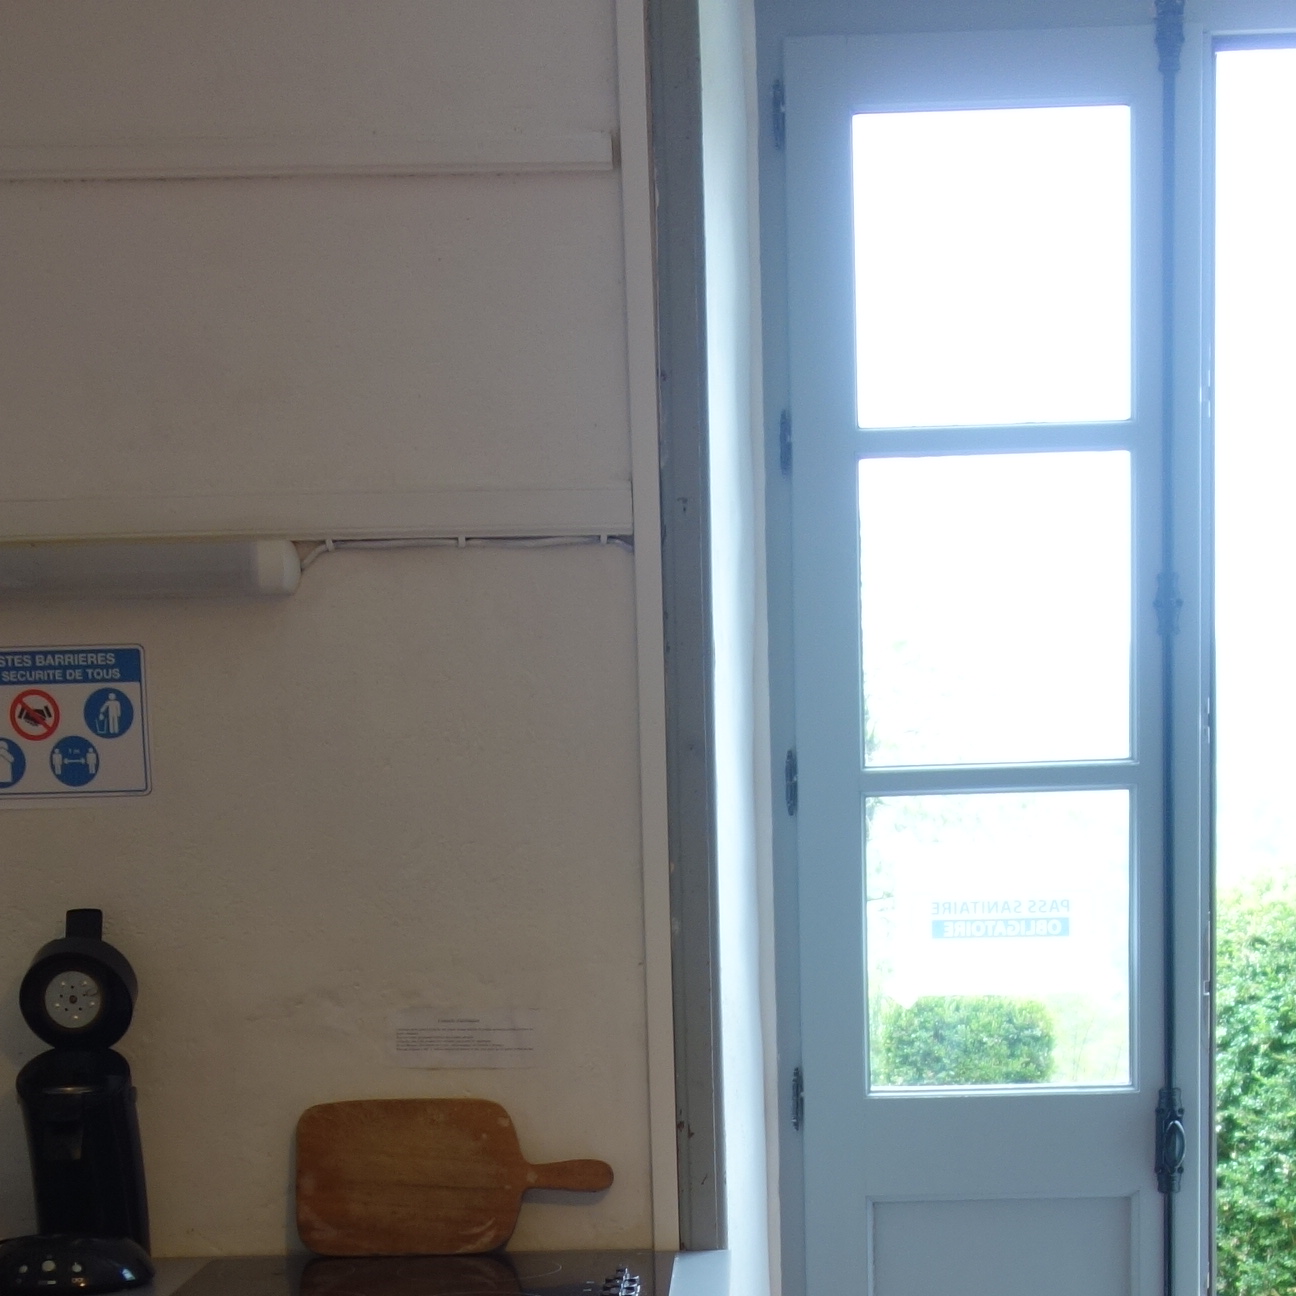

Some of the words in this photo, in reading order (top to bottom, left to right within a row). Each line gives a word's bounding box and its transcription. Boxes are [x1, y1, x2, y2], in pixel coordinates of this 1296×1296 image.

[36, 653, 115, 666] BARRIERES
[2, 670, 63, 681] SECURITE
[68, 669, 83, 680] DE
[86, 668, 121, 679] TOUS
